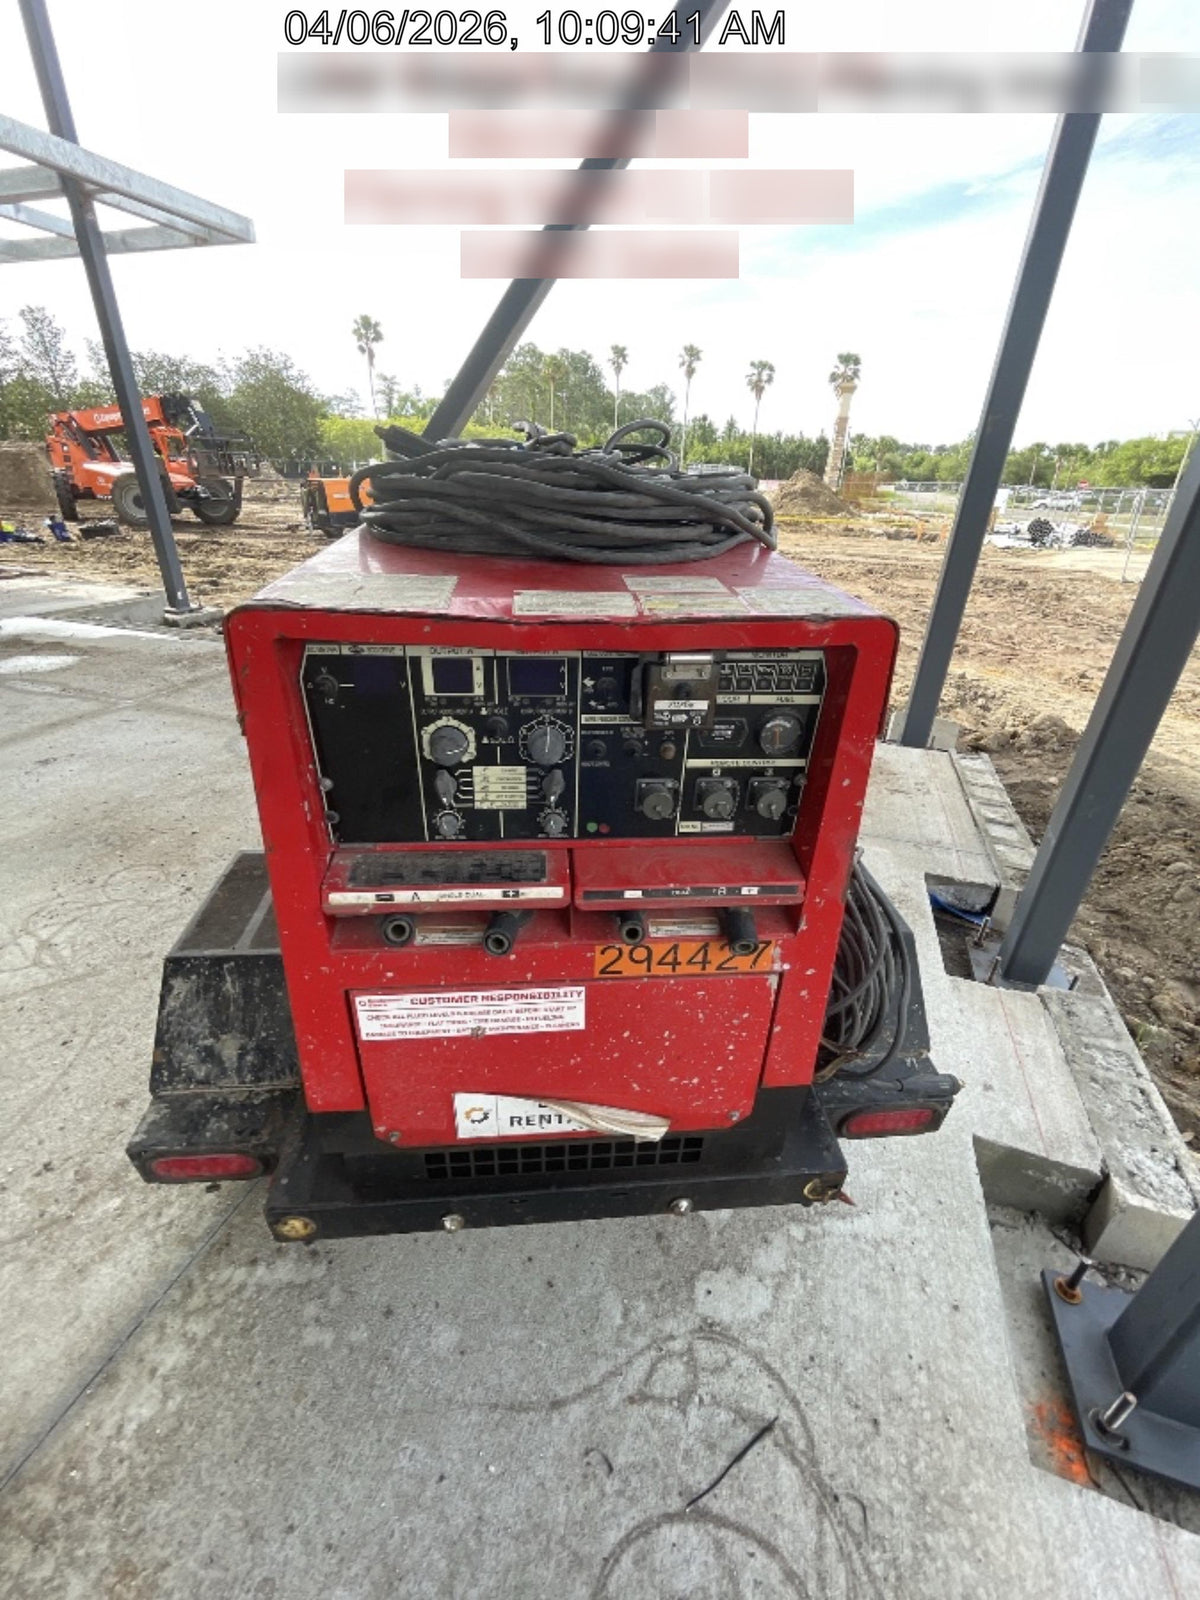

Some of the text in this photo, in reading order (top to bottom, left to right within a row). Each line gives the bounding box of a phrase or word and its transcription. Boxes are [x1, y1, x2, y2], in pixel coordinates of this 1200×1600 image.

[599, 940, 772, 975] 294427
[410, 995, 479, 1006] CUSTOMER
[481, 989, 584, 1003] RESPONSIBILITY
[509, 1113, 573, 1128] RENT
